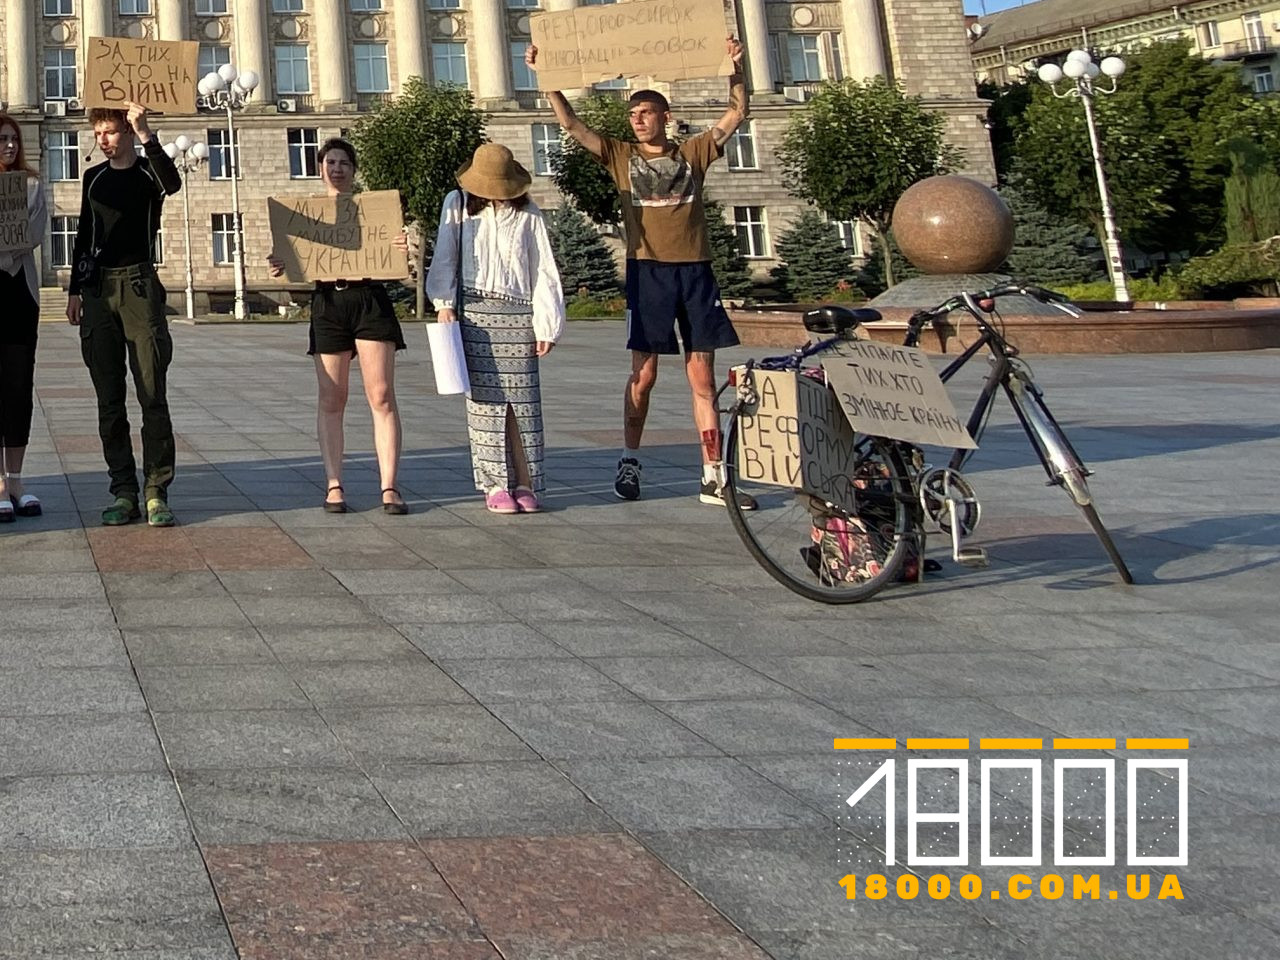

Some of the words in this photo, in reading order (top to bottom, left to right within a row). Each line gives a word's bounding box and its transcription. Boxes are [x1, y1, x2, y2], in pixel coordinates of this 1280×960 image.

[96, 40, 125, 61] ЗА
[135, 45, 170, 62] ТИХ
[110, 62, 152, 80] ХТО
[168, 64, 192, 83] НА
[100, 80, 178, 105] ВІЙНІ
[287, 200, 324, 227] МИ
[342, 198, 366, 223] ЗА
[847, 362, 888, 387] ТИХ
[890, 373, 924, 396] ХТО
[842, 392, 909, 422] ЗМІНЮЄ
[909, 406, 964, 433] КРАЇНУ
